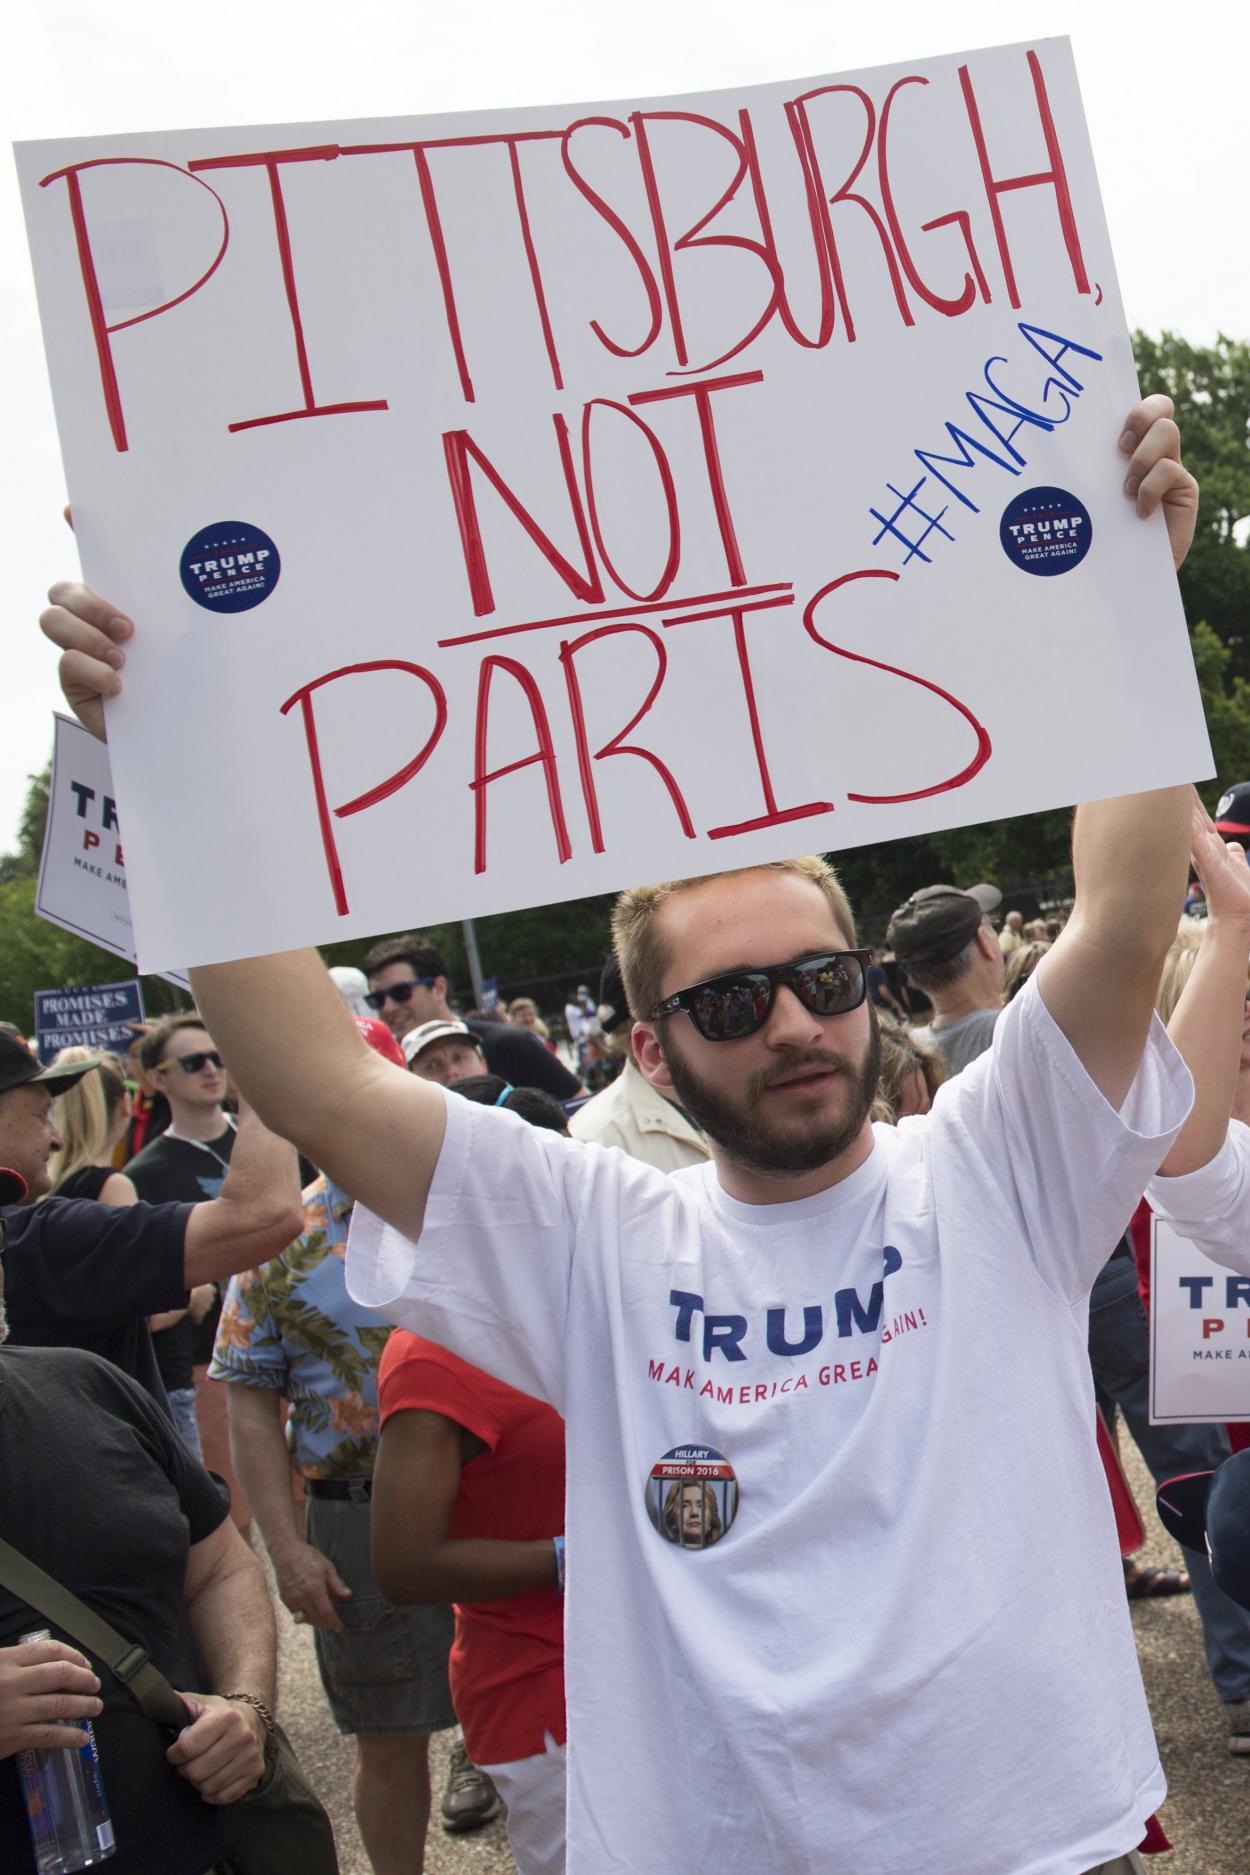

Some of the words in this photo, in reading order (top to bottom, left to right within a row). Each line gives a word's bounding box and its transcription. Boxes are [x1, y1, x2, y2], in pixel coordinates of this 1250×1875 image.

[38, 50, 1102, 452] PITTSBURGH,
[869, 322, 1102, 565] #MAGA
[442, 370, 763, 616] NOT
[1009, 517, 1082, 536] TRUMP
[1017, 529, 1078, 544] PENCE
[1021, 546, 1043, 555] MAKE
[1044, 542, 1078, 552] AMERICA
[1024, 552, 1049, 560] GREAT
[189, 549, 270, 575] TRUMP
[198, 562, 265, 582] PENCE
[203, 583, 228, 592] MAKE
[228, 576, 267, 587] AMERICA
[207, 588, 235, 599] GREAT
[280, 569, 992, 916] PARIS
[73, 856, 103, 878] MAKE
[42, 990, 128, 1014] PROMISES
[55, 1010, 108, 1027] MADE
[44, 1025, 134, 1048] PROMISES
[648, 1359, 695, 1389] MAK
[699, 1374, 809, 1405] AMERICA
[818, 1357, 878, 1387] GREA
[880, 1308, 928, 1344] GAIN!
[1193, 1350, 1233, 1360] MAKE
[675, 1450, 710, 1459] HILLARY
[662, 1466, 694, 1475] PRISON
[696, 1467, 719, 1475] 2016
